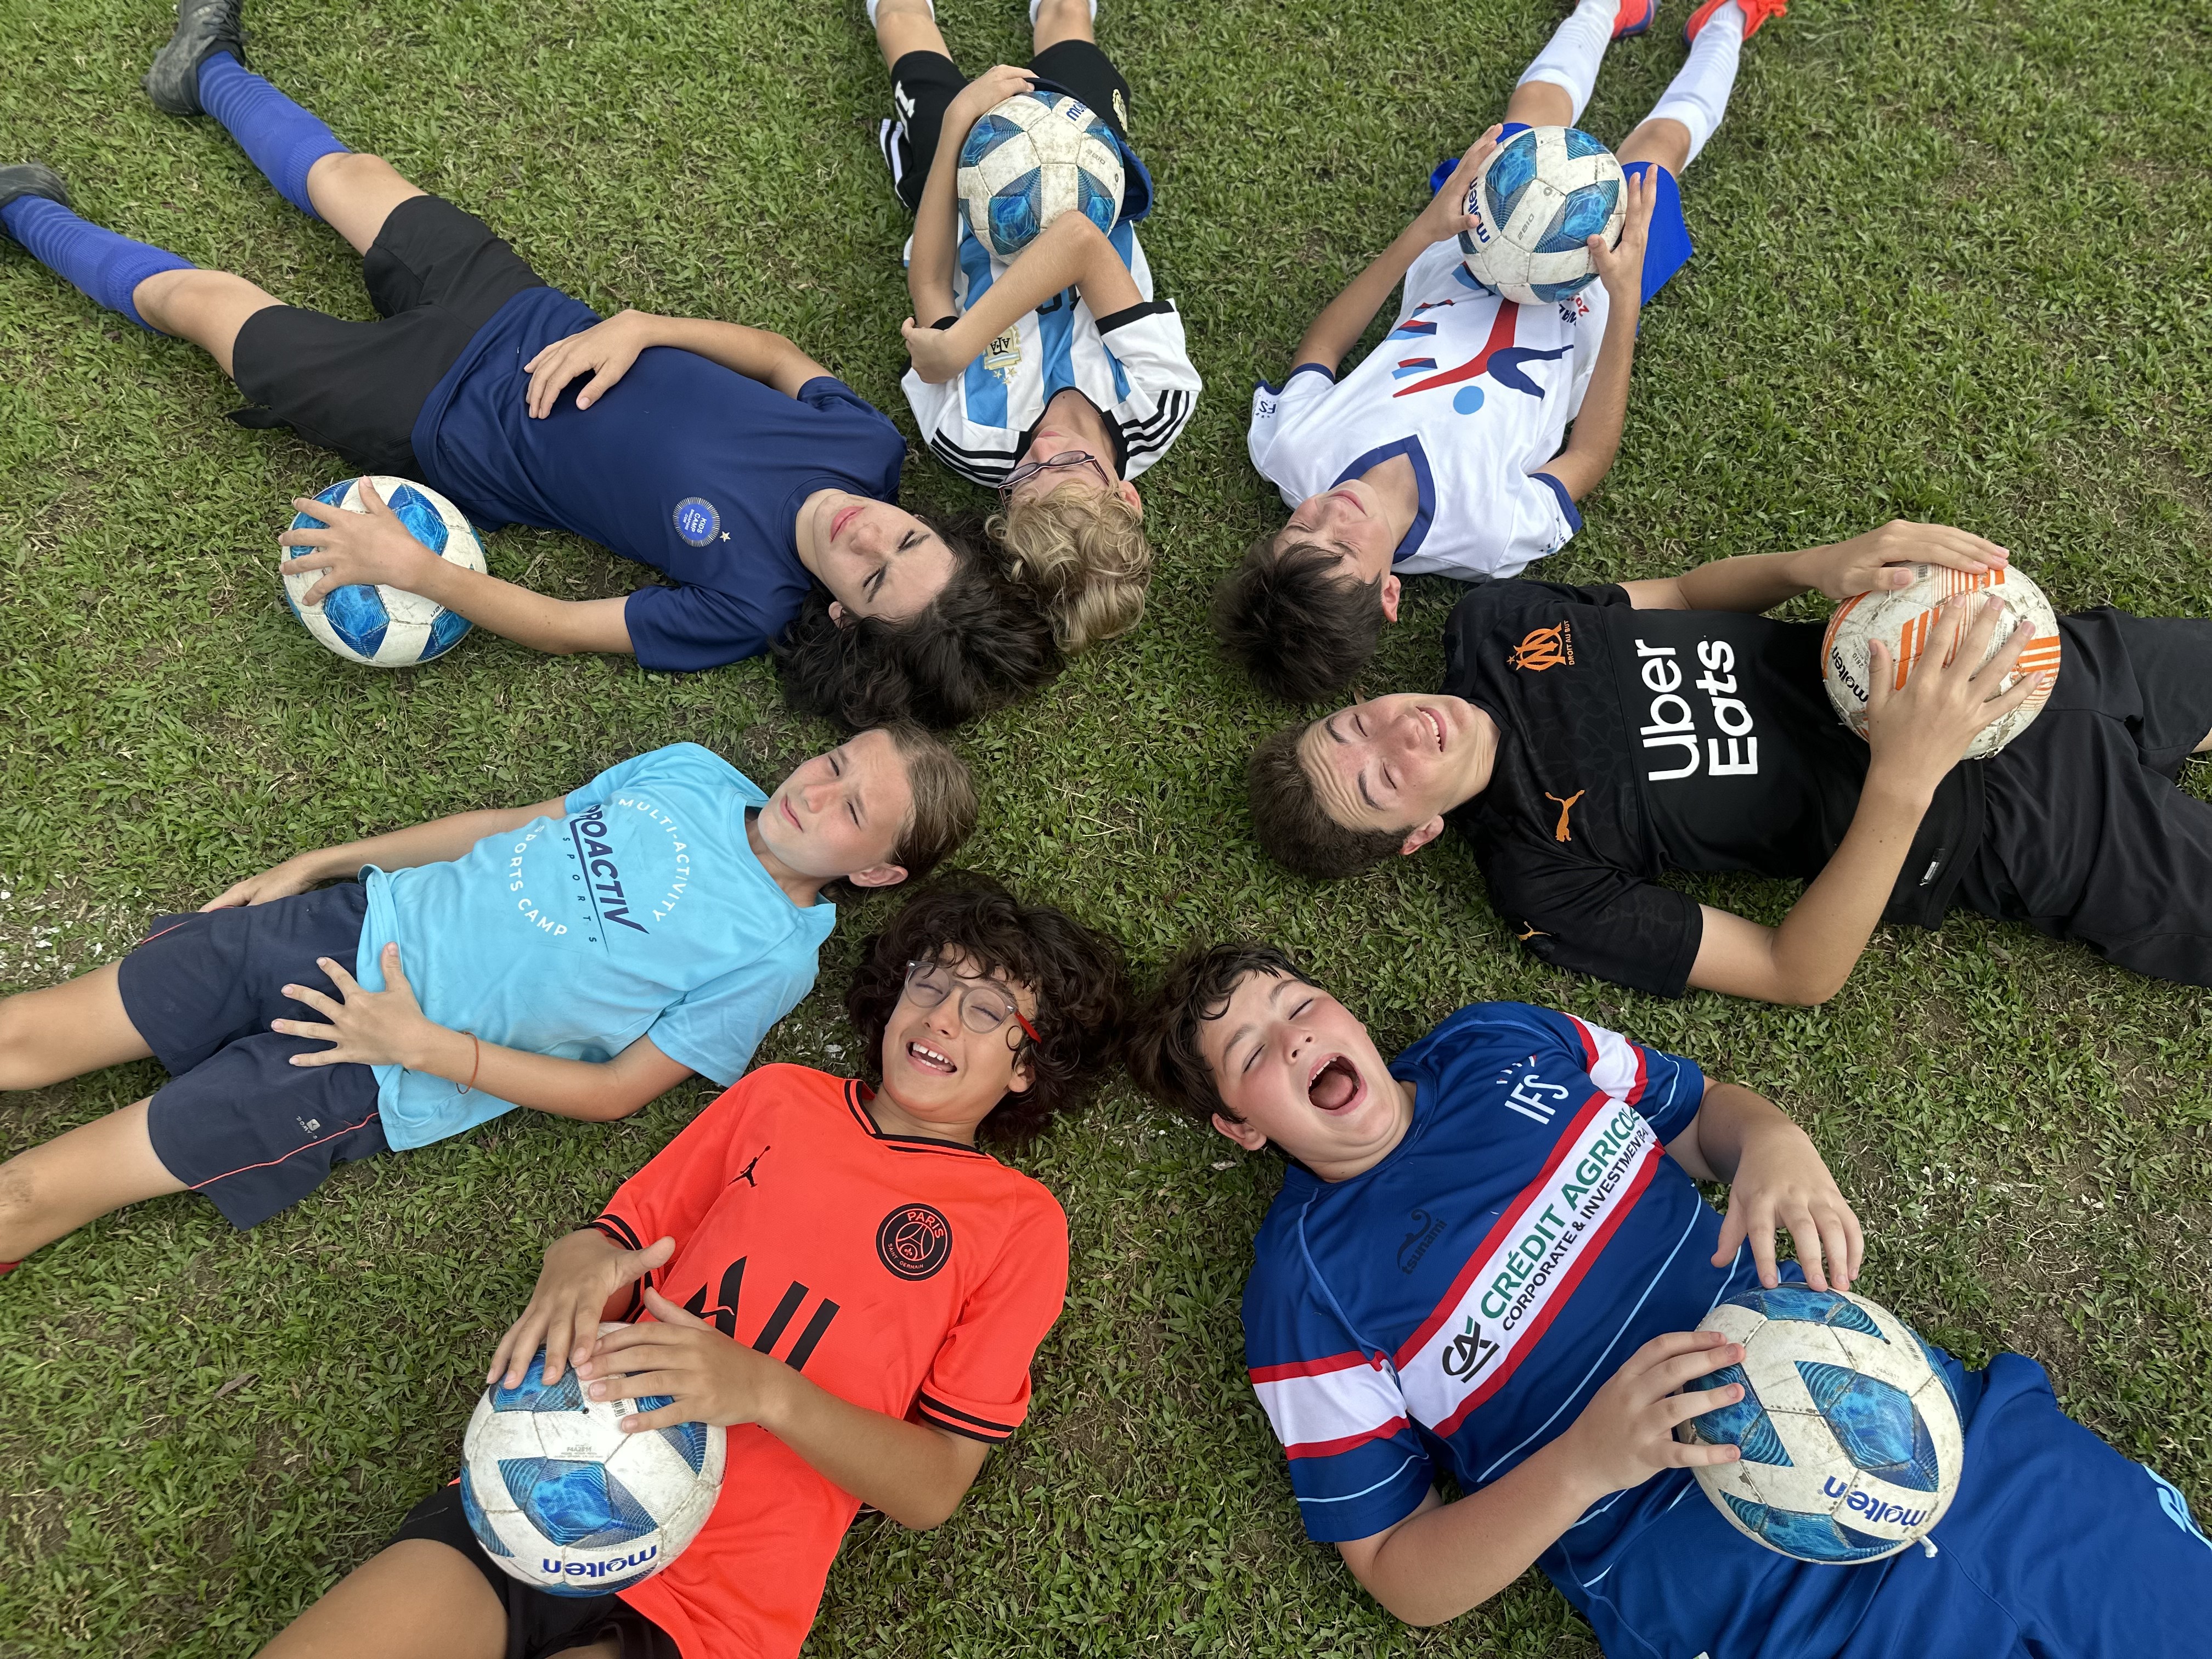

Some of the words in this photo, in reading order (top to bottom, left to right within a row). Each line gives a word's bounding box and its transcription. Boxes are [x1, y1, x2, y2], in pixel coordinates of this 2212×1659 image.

[1517, 213, 1536, 241] 2810
[990, 337, 1011, 356] AFA
[690, 512, 701, 533] CAMP
[698, 518, 707, 534] KIDS
[1563, 619, 1571, 631] BUT
[1566, 632, 1573, 642] AU
[1567, 644, 1576, 665] DROIT
[1852, 652, 1864, 669] 2810
[1832, 646, 1869, 702] molten
[1635, 639, 1700, 781] Uber
[1696, 640, 1758, 776] Eats
[509, 824, 545, 893] SPORTS
[618, 798, 690, 923] MULTI-ACTIVITY
[562, 837, 597, 943] SPORTS
[517, 898, 568, 936] CAMP
[1504, 1073, 1570, 1125] IFS
[296, 1116, 318, 1139] DOMYS
[907, 1211, 944, 1239] PARIS
[1503, 1231, 1578, 1331] CORPORATE
[1571, 1216, 1585, 1233] &
[1582, 1136, 1642, 1221] INVESTMEN
[1402, 1218, 1447, 1274] tsunami
[1480, 1201, 1566, 1319] CRÉDIT
[1822, 1474, 1927, 1528] molten
[543, 1544, 657, 1577] molten
